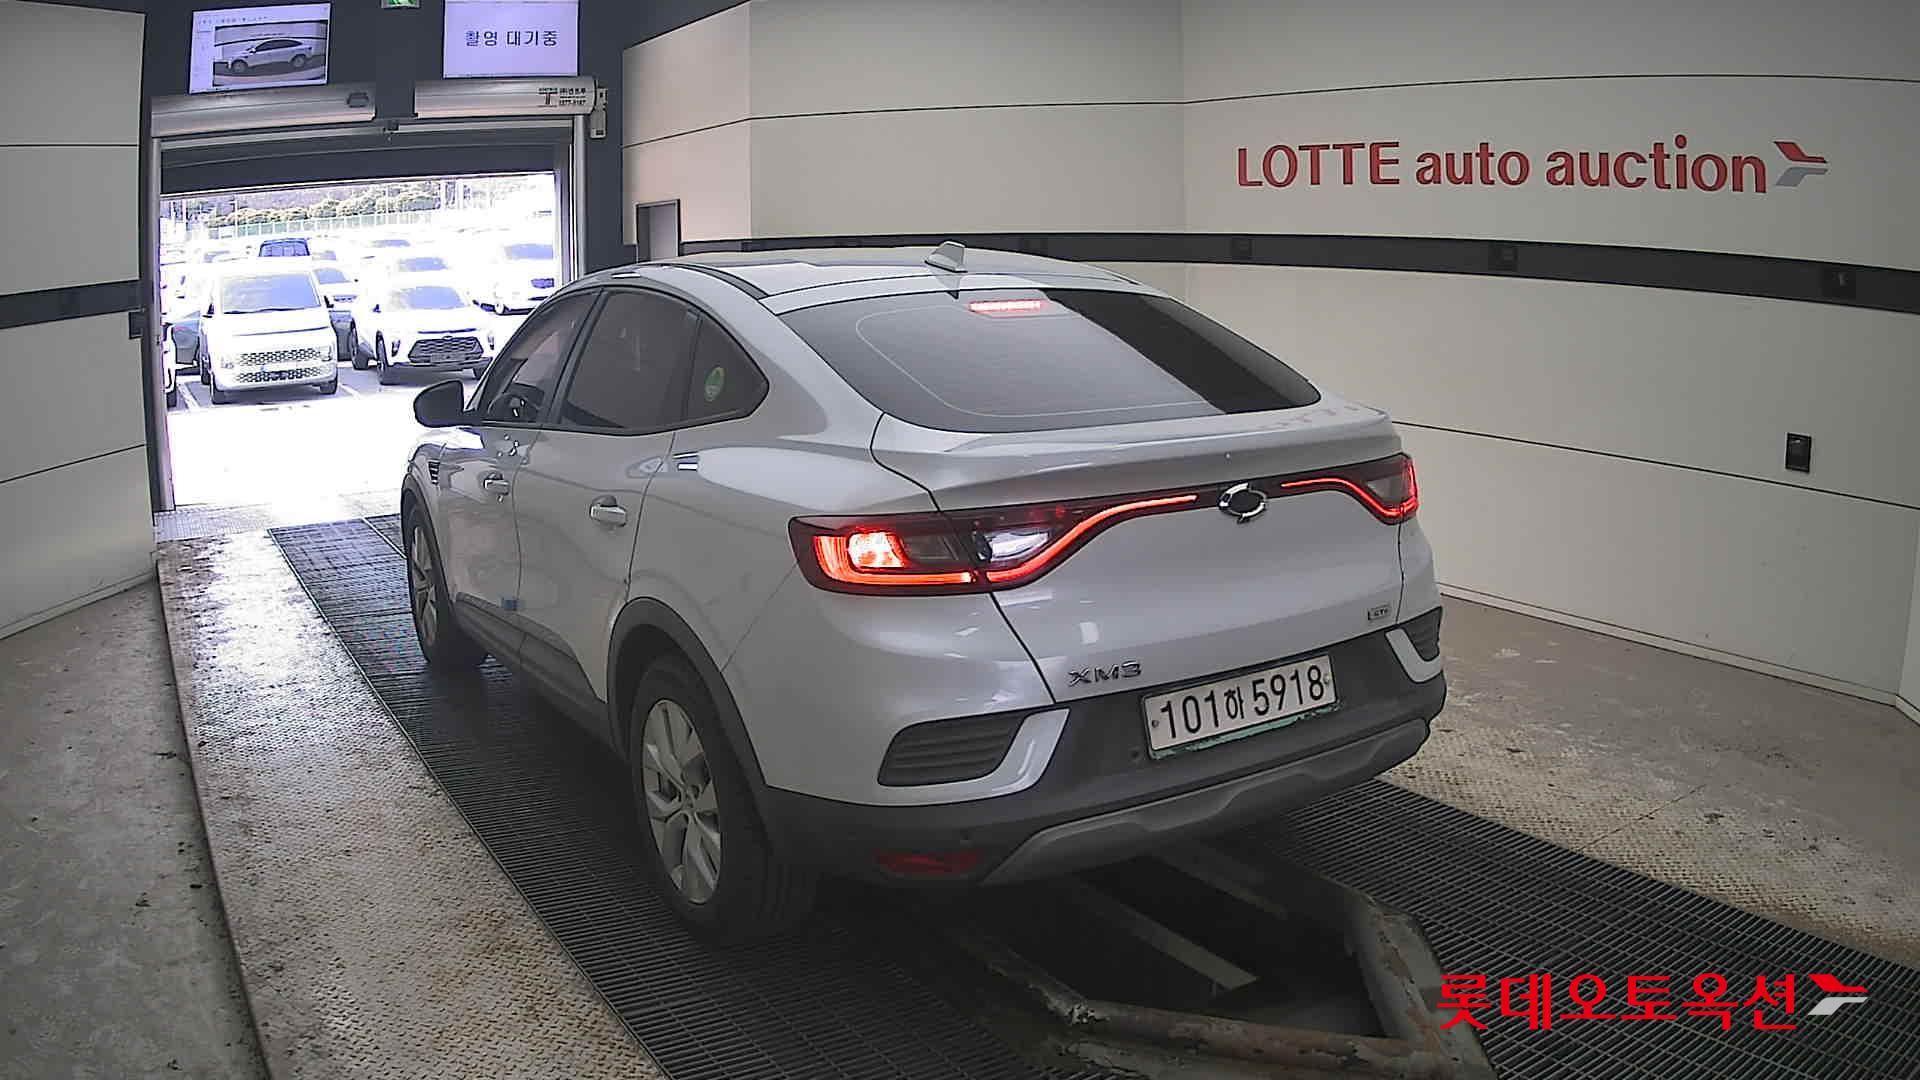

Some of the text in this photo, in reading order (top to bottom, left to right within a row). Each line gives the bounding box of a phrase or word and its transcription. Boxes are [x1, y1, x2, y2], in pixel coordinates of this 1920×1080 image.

[466, 30, 558, 47] 촬영 대기중
[1237, 134, 1767, 193] LOTTE auto auction
[1067, 660, 1141, 688] XM3
